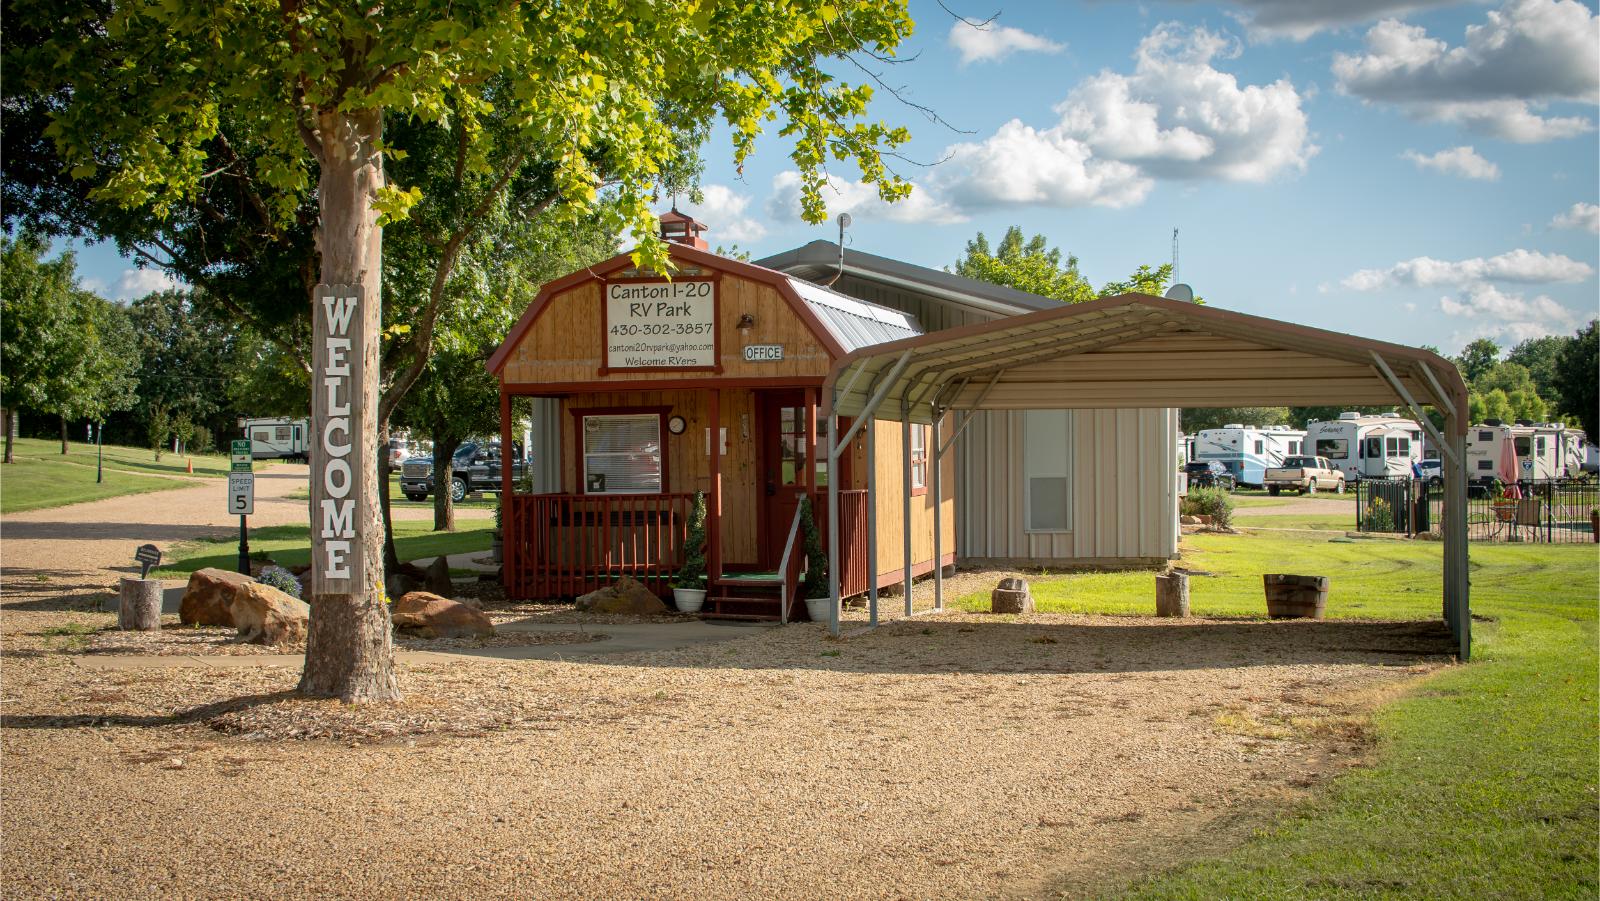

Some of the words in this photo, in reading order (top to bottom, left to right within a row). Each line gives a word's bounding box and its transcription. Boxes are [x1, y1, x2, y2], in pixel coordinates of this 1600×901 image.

[611, 285, 669, 299] Canton
[630, 303, 653, 317] RV
[657, 302, 691, 317] Park
[610, 323, 713, 336] 430-302-3857
[746, 347, 780, 358] OFFICE
[625, 357, 666, 366] Welcome
[668, 357, 697, 365] RVers
[321, 296, 357, 579] WELCOME
[236, 495, 247, 509] 5
